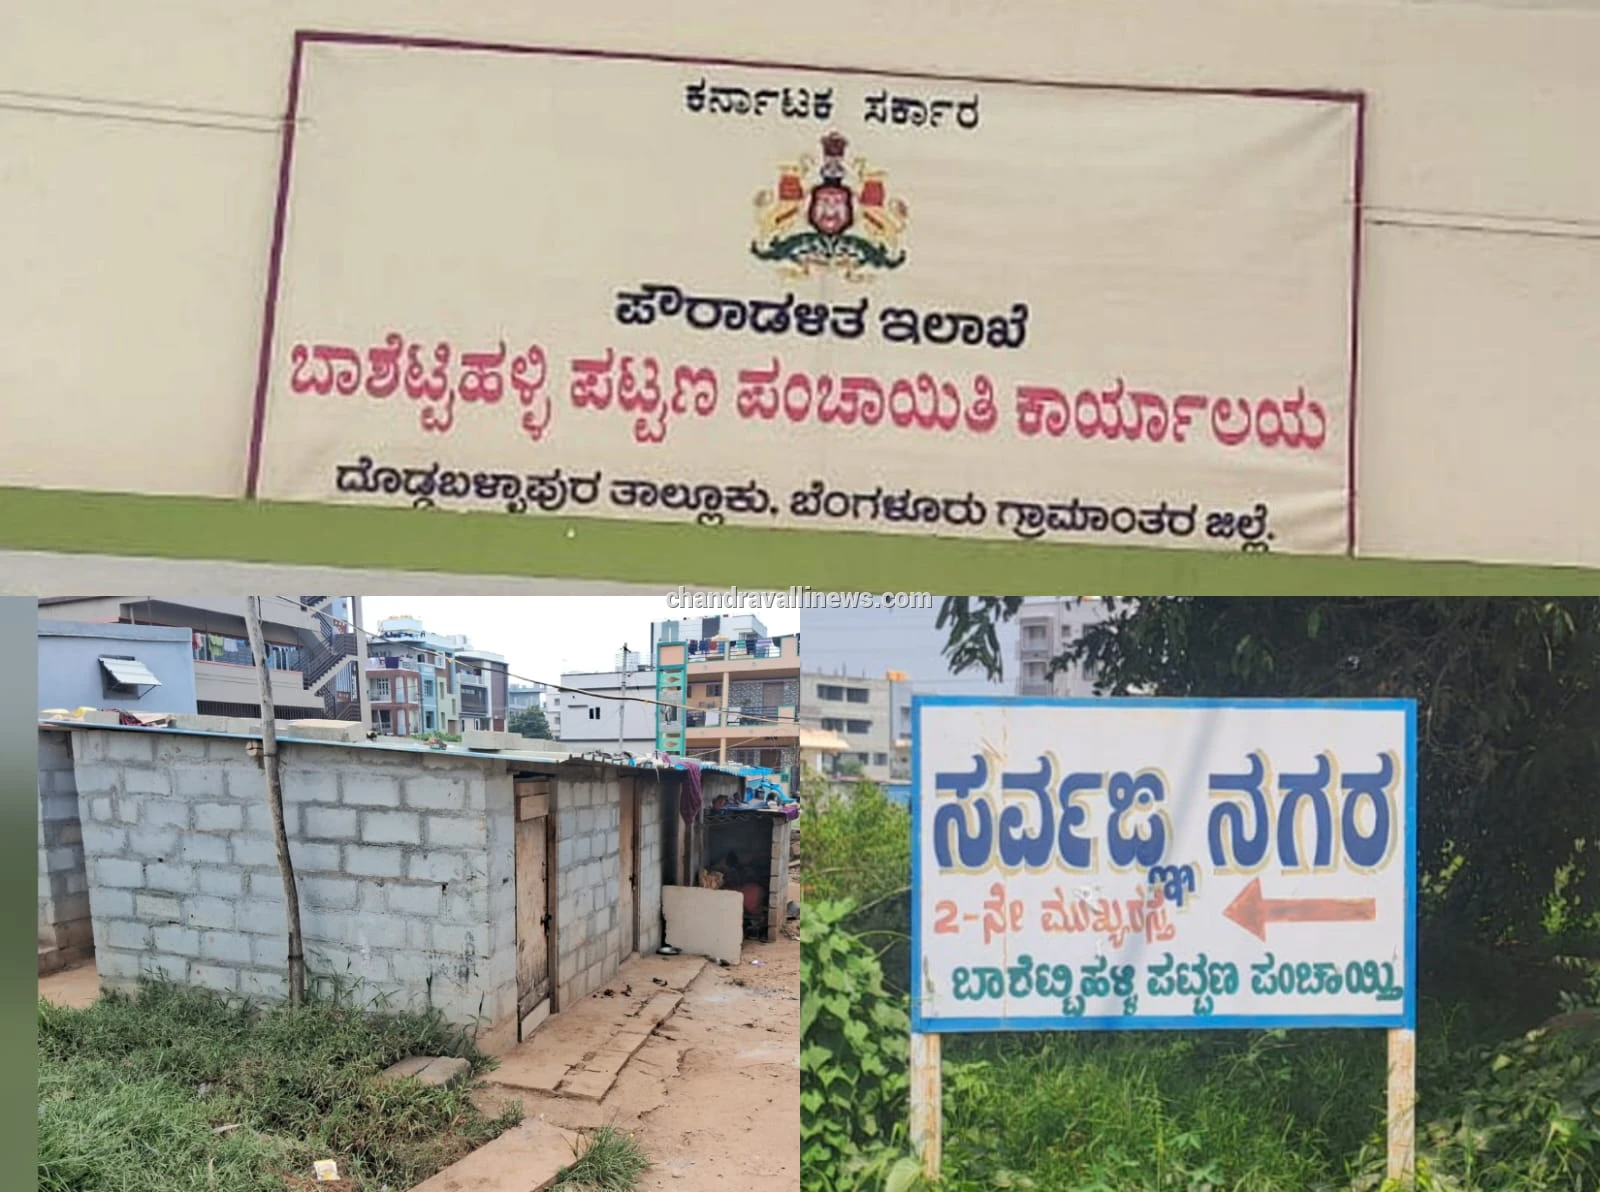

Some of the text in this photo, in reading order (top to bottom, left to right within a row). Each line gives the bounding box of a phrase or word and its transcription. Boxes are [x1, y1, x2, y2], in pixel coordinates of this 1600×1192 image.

[686, 78, 980, 130] ಕರ್ನಾಟಕ ಸರ್ಕಾರ
[615, 282, 1030, 350] ಪೌರಾಡಳಿತ ಇಲಾಖೆ
[291, 332, 1327, 451] ಬಾಶೆಟ್ಟಿಹಳ್ಳಿ ಪಟ್ಟಣ ಪಂಚಾಯಿತಿ ಕಾರ್ಯಾಲಯ
[336, 454, 602, 515] ದೊಡ್ಡಬಳ್ಳಾಪುರ
[790, 480, 987, 526] ಬೆಂಗಳೂರು
[996, 498, 1198, 539] ಗ್ರಾಮಾಂತರ
[933, 751, 1397, 908] ಸರ್ವಜ್ಞ ನಗರ
[933, 882, 1025, 945] 2-ನೇ
[1147, 952, 1240, 1016] ಪಟ್ಟಣ
